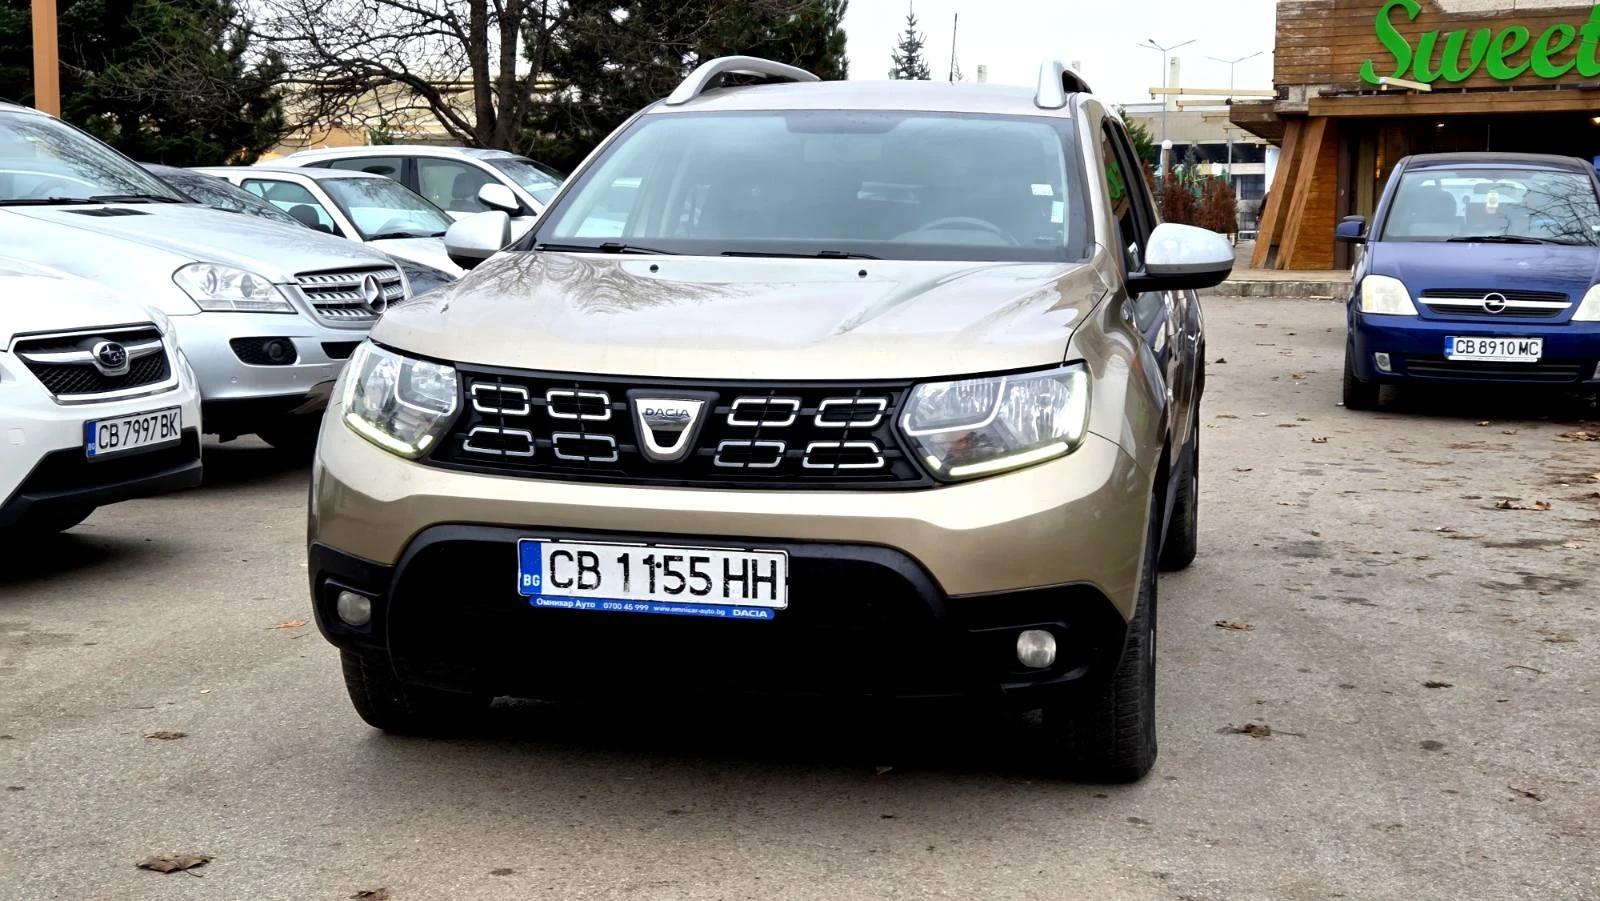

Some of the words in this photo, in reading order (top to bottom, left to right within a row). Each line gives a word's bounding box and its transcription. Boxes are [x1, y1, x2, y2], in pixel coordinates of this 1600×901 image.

[1359, 0, 1600, 84] Sweet
[1455, 339, 1475, 354] CB
[1478, 340, 1516, 355] 8910
[1518, 341, 1539, 356] MC
[644, 407, 690, 418] DACIA
[98, 423, 119, 449] CB
[122, 415, 158, 446] 7997
[160, 411, 178, 438] BK
[523, 574, 541, 587] BG
[549, 549, 601, 590] CB
[616, 552, 713, 596] 1155
[722, 557, 777, 600] HH
[575, 600, 596, 610] Ауто
[603, 602, 622, 610] 0700
[623, 603, 634, 611] 45
[732, 609, 768, 618] DACIA
